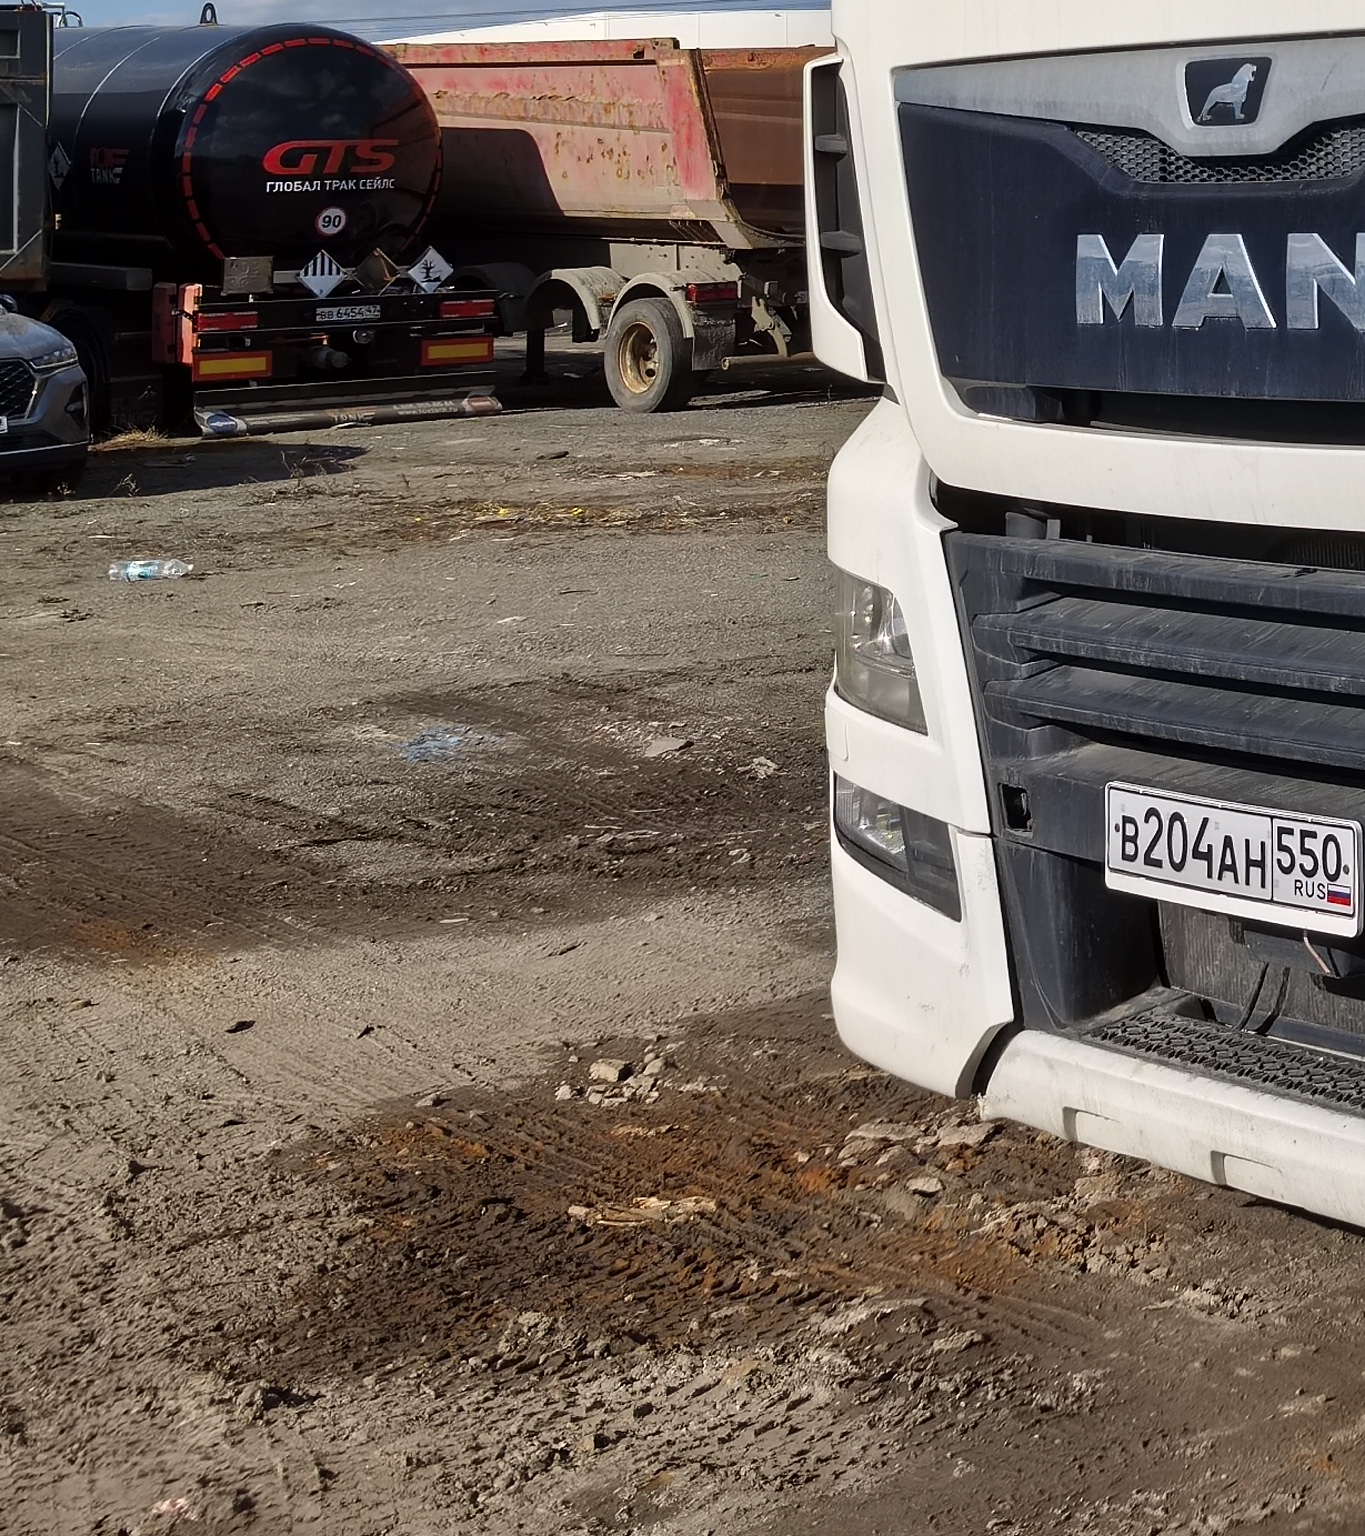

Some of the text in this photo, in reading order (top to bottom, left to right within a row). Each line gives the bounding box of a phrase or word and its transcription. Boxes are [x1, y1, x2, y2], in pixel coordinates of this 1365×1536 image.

[262, 139, 399, 175] GTS
[265, 176, 396, 193] ГЛОБАЛ ТРАК СЕЙЛС
[321, 214, 342, 229] 90
[1121, 806, 1343, 889] В204АН 550
[1294, 879, 1327, 901] RUS
